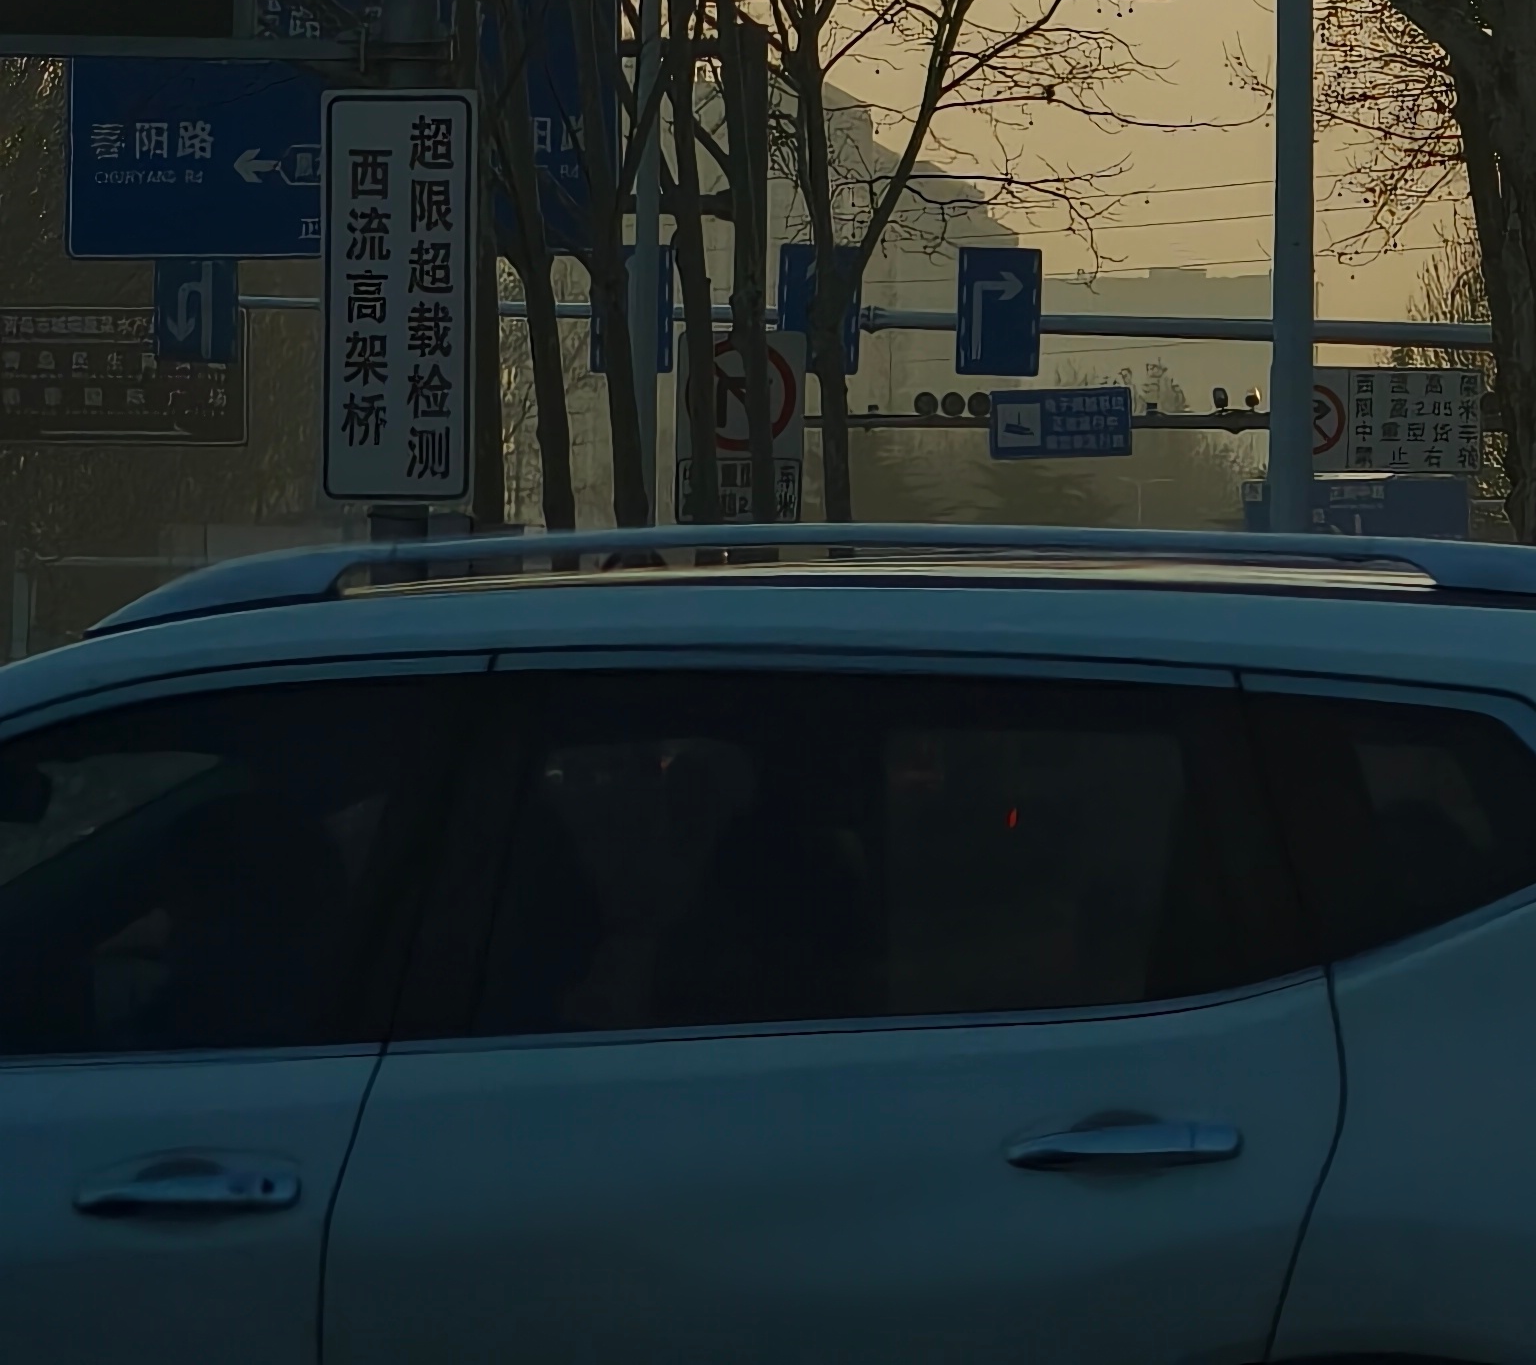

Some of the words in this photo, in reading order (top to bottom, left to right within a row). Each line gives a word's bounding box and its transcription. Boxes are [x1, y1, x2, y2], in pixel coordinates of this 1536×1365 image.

[342, 150, 393, 447] 西流高架桥
[406, 115, 455, 481] 超限超载检测
